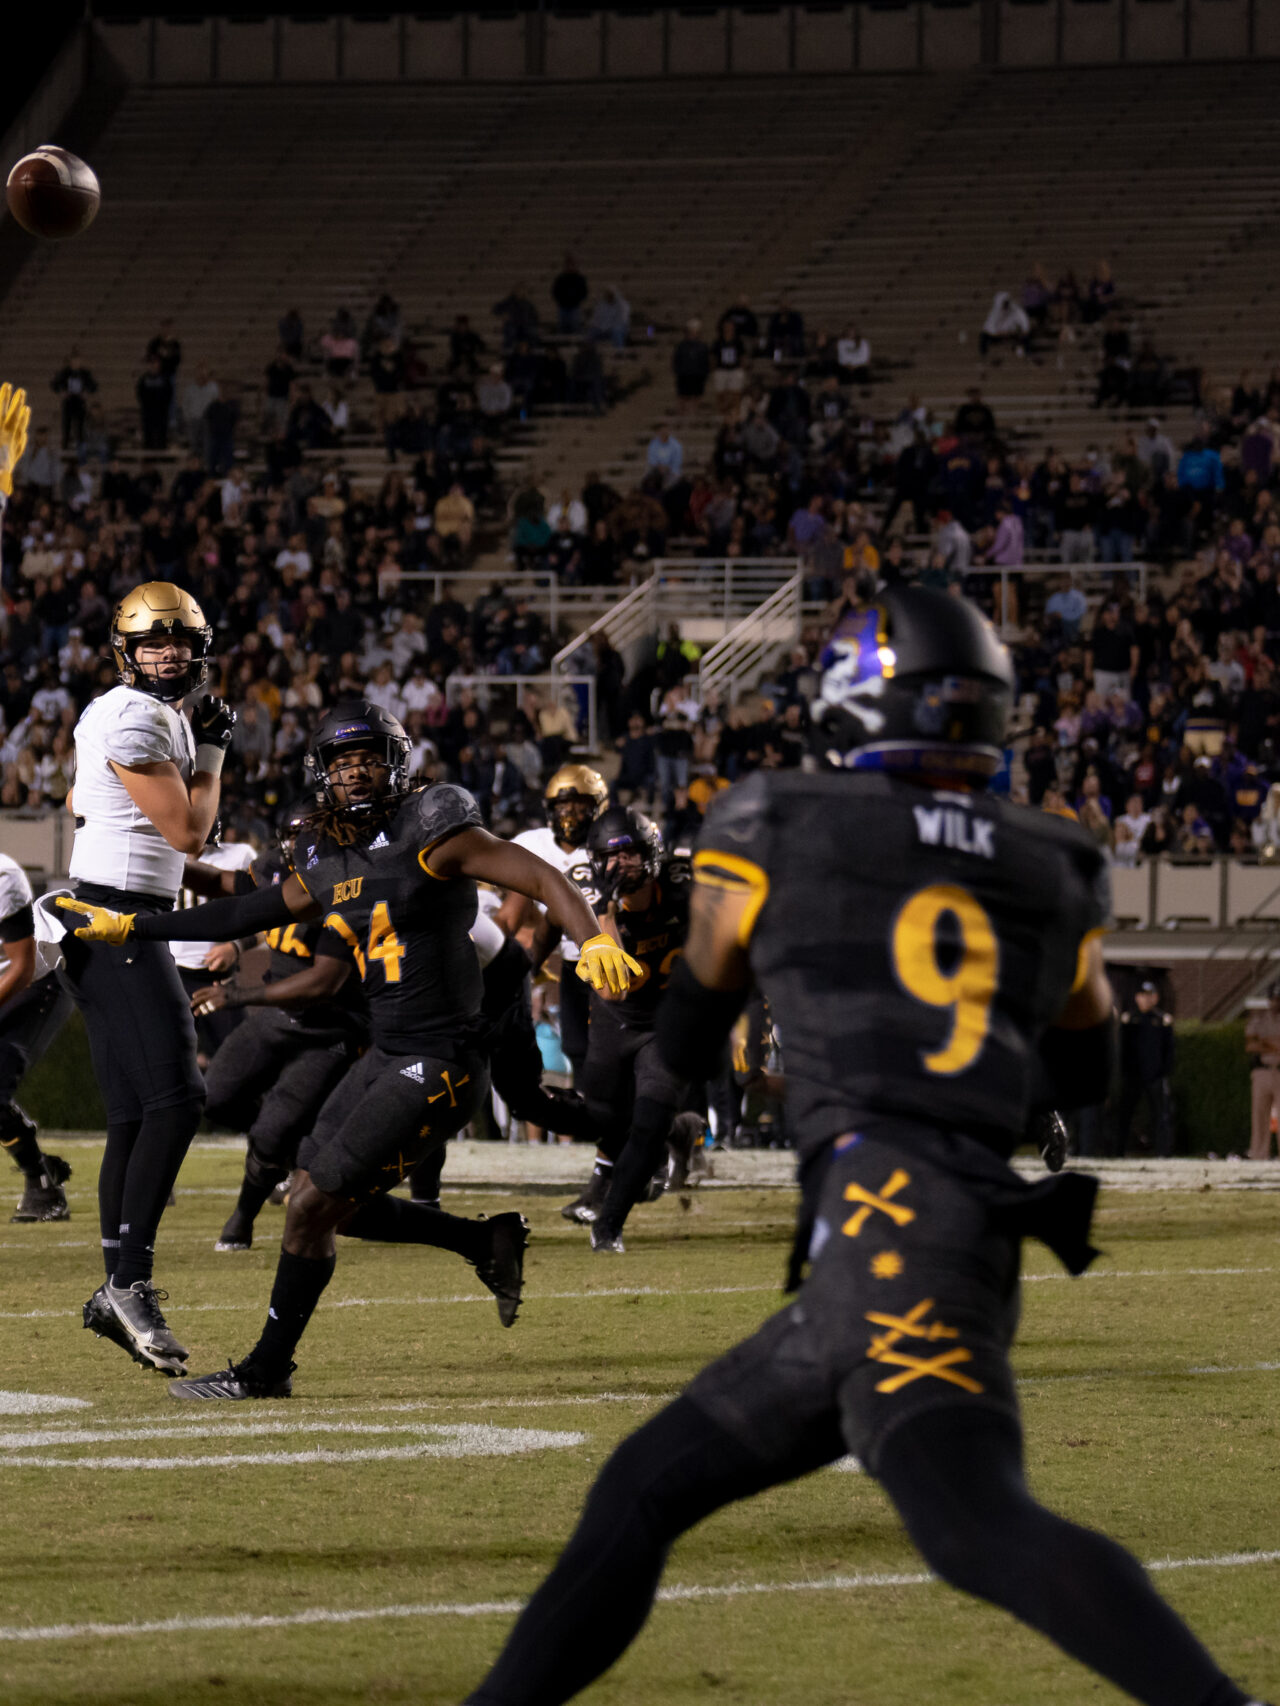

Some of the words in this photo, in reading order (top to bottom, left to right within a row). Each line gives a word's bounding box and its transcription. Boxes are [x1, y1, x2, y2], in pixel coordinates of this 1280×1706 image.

[912, 805, 996, 859] WILK
[331, 876, 364, 905] ECU
[889, 884, 1003, 1077] 9
